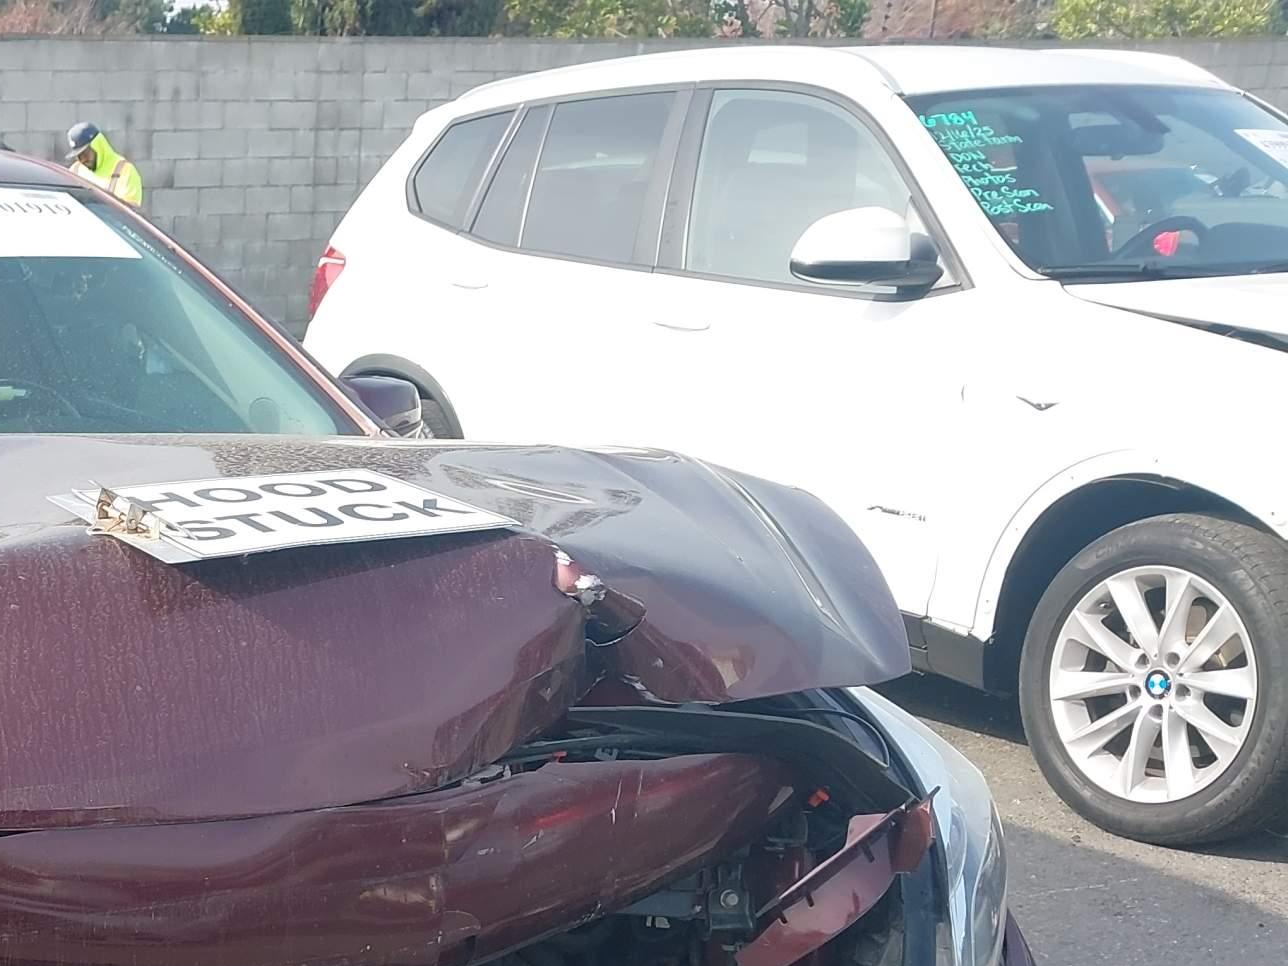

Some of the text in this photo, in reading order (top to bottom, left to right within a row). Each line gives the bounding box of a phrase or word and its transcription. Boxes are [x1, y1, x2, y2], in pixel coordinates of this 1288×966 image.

[919, 111, 977, 127] 6784
[962, 172, 1017, 187] Photos
[970, 186, 1040, 201] Pre Scan
[979, 198, 1055, 215] Post Scan
[127, 478, 387, 513] HOOD
[175, 498, 477, 541] STUCK
